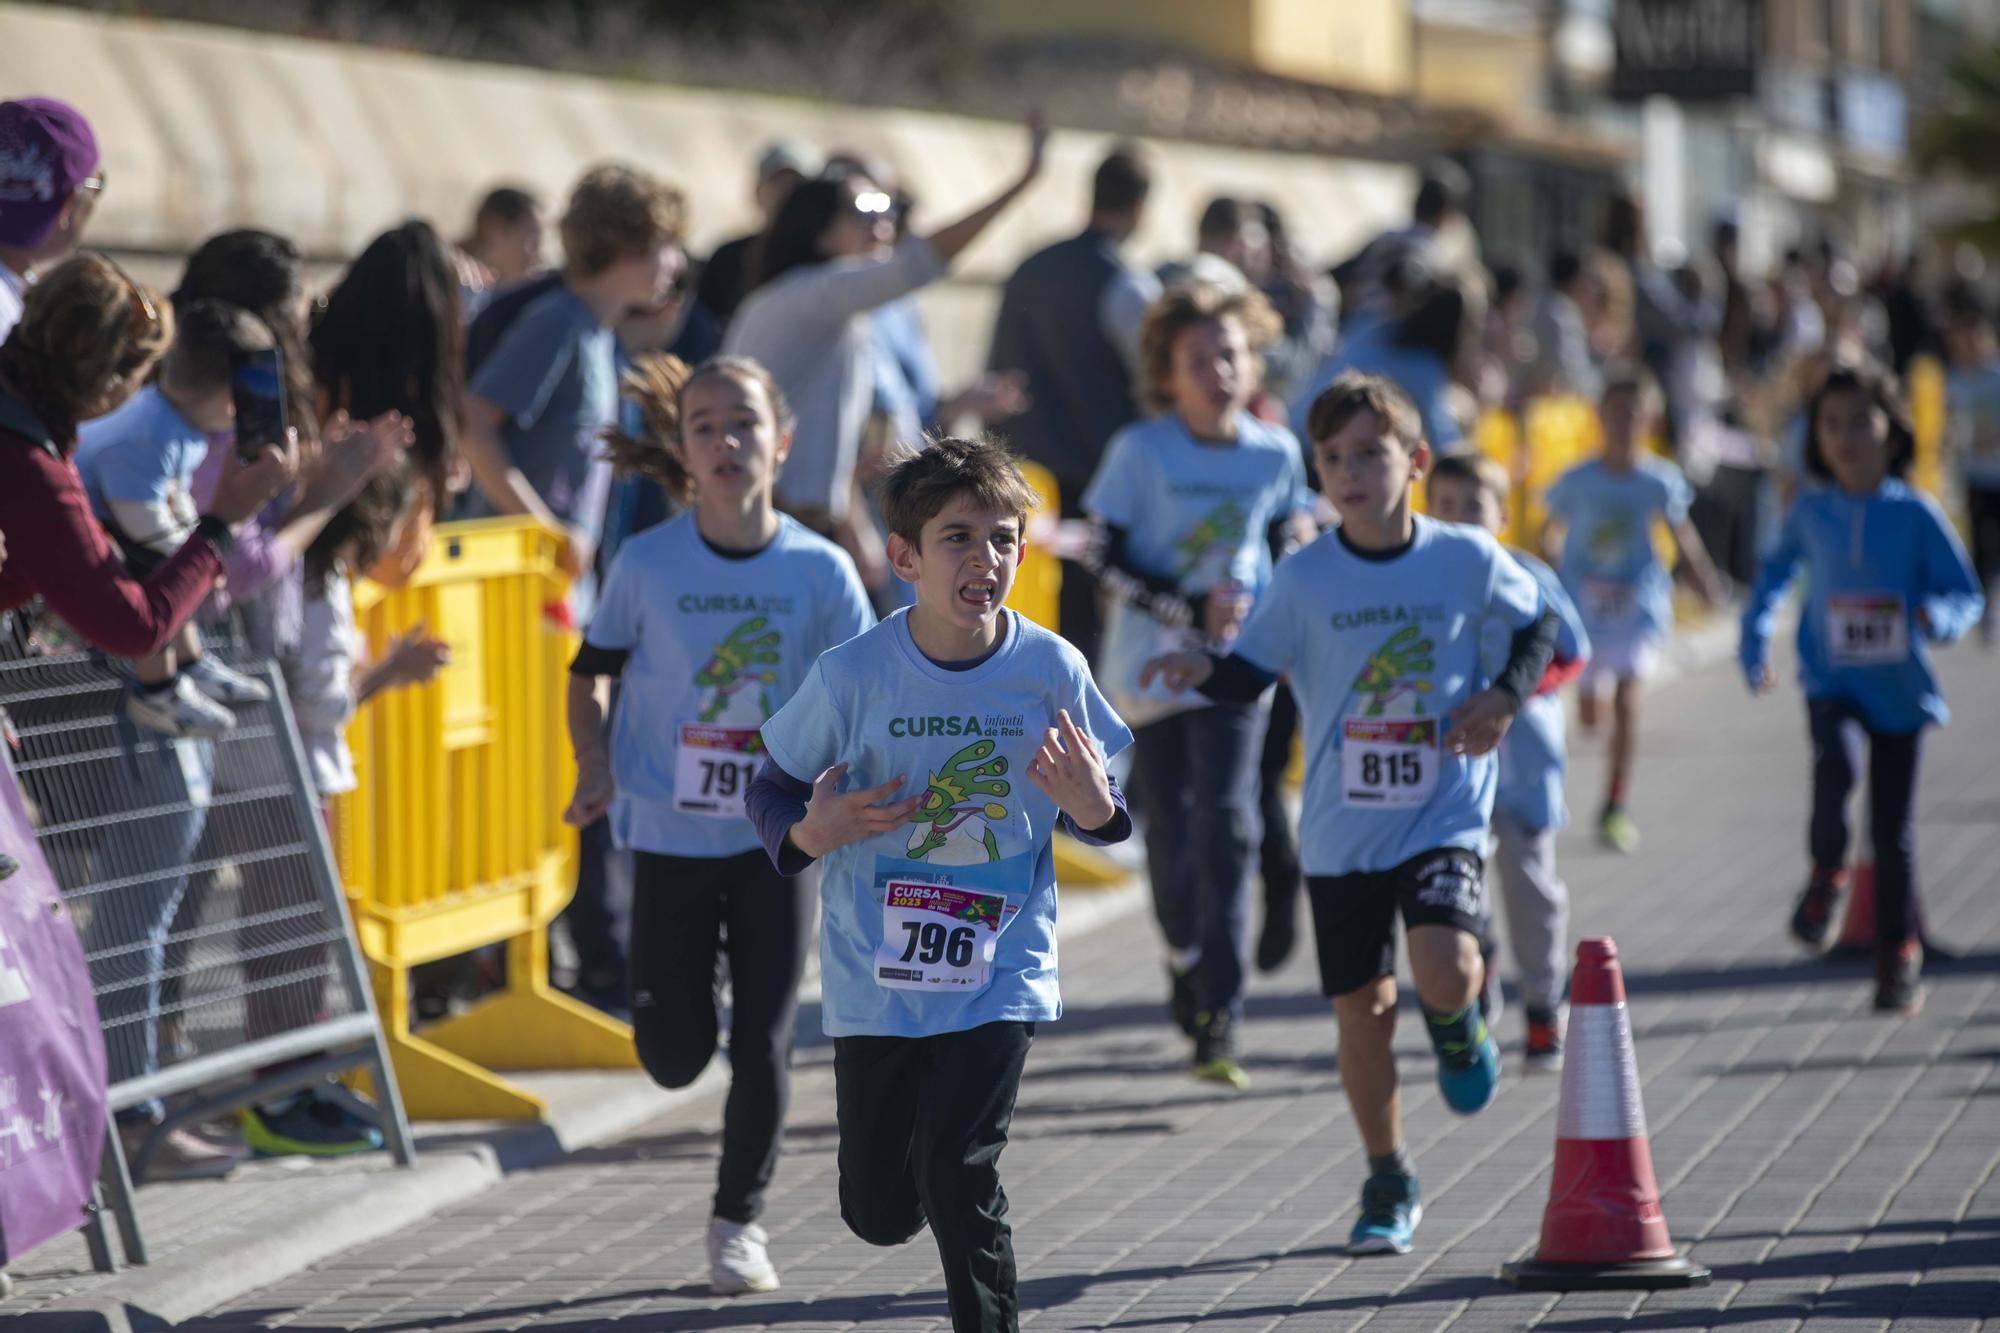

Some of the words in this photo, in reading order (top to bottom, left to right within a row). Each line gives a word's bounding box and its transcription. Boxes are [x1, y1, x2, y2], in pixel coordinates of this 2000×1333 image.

[677, 593, 756, 614] CURSA
[1330, 604, 1408, 630] CURSA
[888, 716, 983, 738] CURSA
[984, 714, 1024, 728] infantil
[984, 727, 998, 737] de
[1001, 727, 1024, 737] Reis
[699, 760, 754, 797] 791
[1362, 752, 1422, 787] 815
[892, 897, 922, 907] 2023
[894, 886, 942, 900] CURSA
[898, 921, 976, 968] 796
